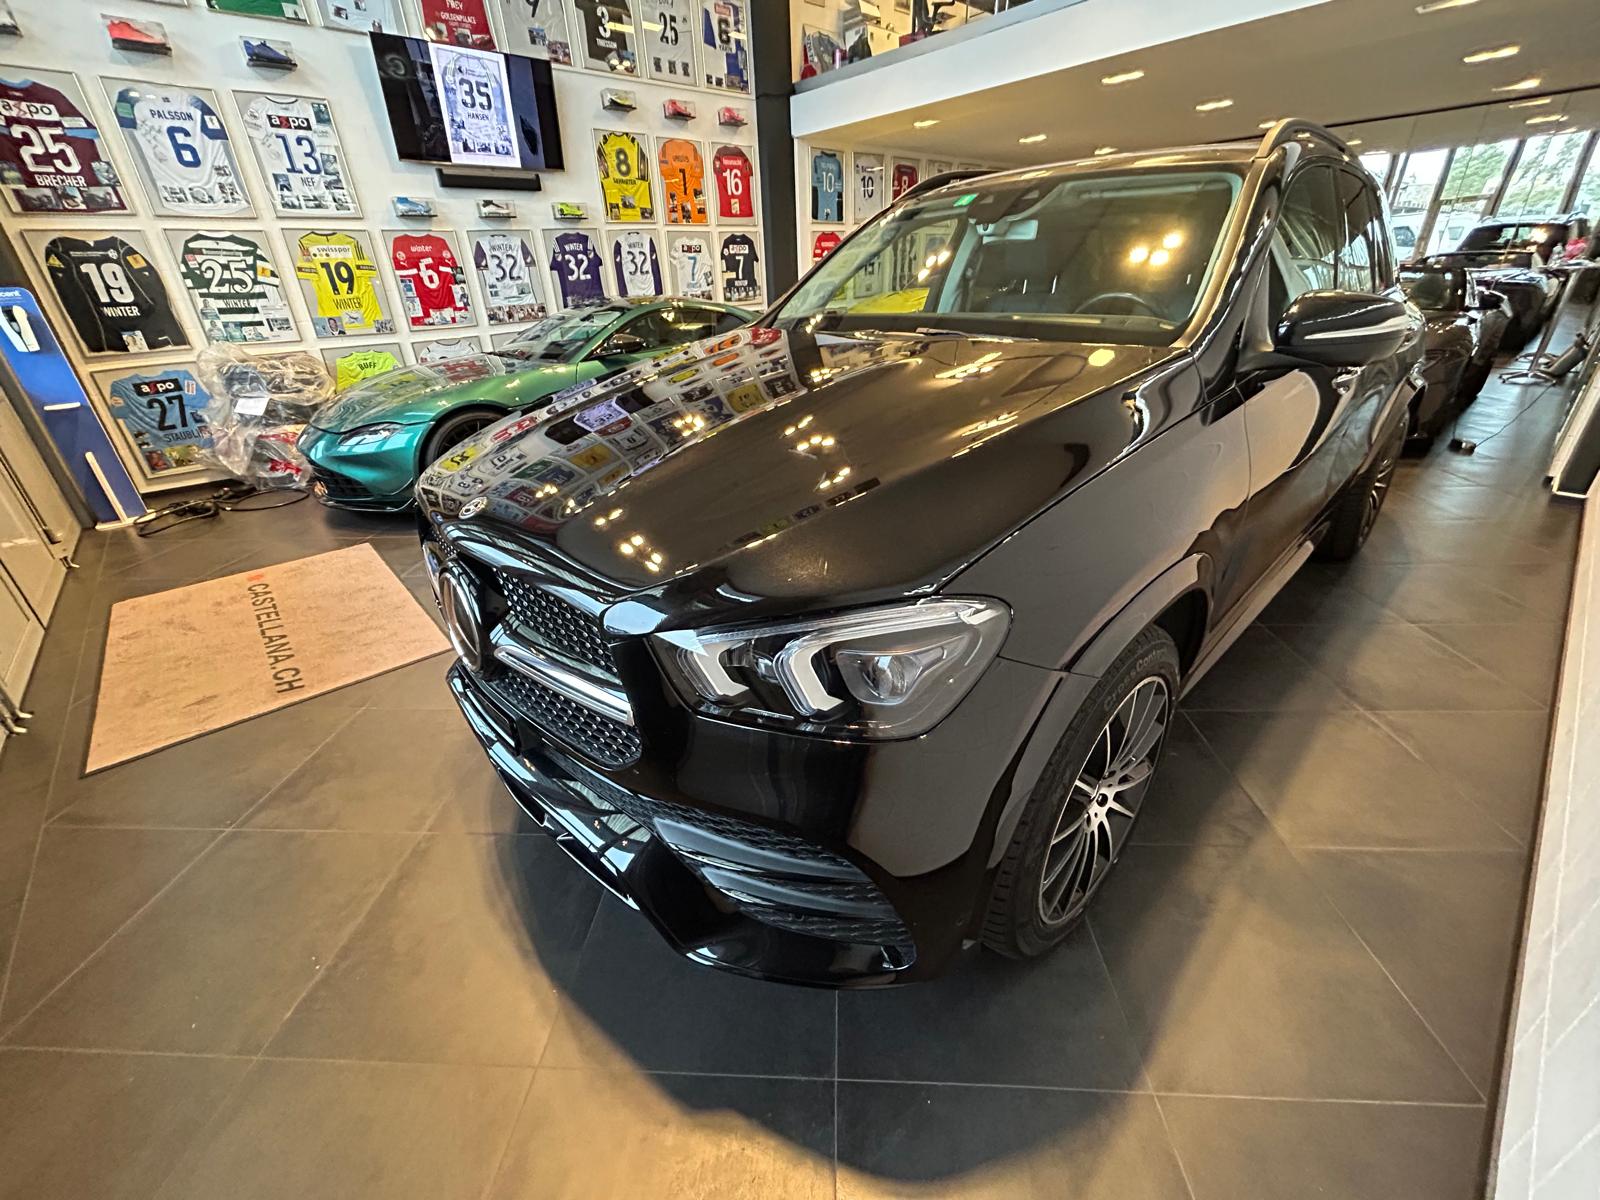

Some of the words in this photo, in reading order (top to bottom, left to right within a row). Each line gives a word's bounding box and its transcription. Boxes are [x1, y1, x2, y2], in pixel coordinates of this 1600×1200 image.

[596, 6, 611, 38] 3
[659, 11, 679, 46] 25
[458, 78, 492, 111] 35
[149, 108, 194, 121] PALSSON
[467, 112, 490, 121] HANSEN
[10, 124, 81, 174] 25
[166, 125, 201, 168] 6
[275, 133, 322, 174] 13
[615, 147, 631, 177] 8
[35, 174, 87, 187] BRECHER
[300, 176, 316, 187] NEF
[679, 168, 687, 195] 1
[722, 168, 743, 196] 16
[822, 171, 835, 193] 10
[861, 175, 874, 199] 10
[317, 246, 351, 254] swisspor
[410, 244, 433, 253] winter
[490, 243, 515, 253] WINTER
[564, 242, 584, 252] WINTER
[201, 258, 254, 294] 25
[418, 257, 440, 289] 6
[490, 254, 522, 282] 32
[564, 253, 592, 281] 32
[627, 250, 650, 275] 32
[687, 255, 697, 282] 7
[735, 255, 744, 280] 7
[80, 262, 135, 304] 19
[320, 261, 355, 296] 19
[102, 305, 141, 317] WINTER
[223, 299, 252, 308] WINTER
[333, 296, 364, 310] WINTER
[358, 361, 378, 371] BUFF
[146, 394, 190, 432] 27
[247, 583, 306, 694] CASTELLANA.CH
